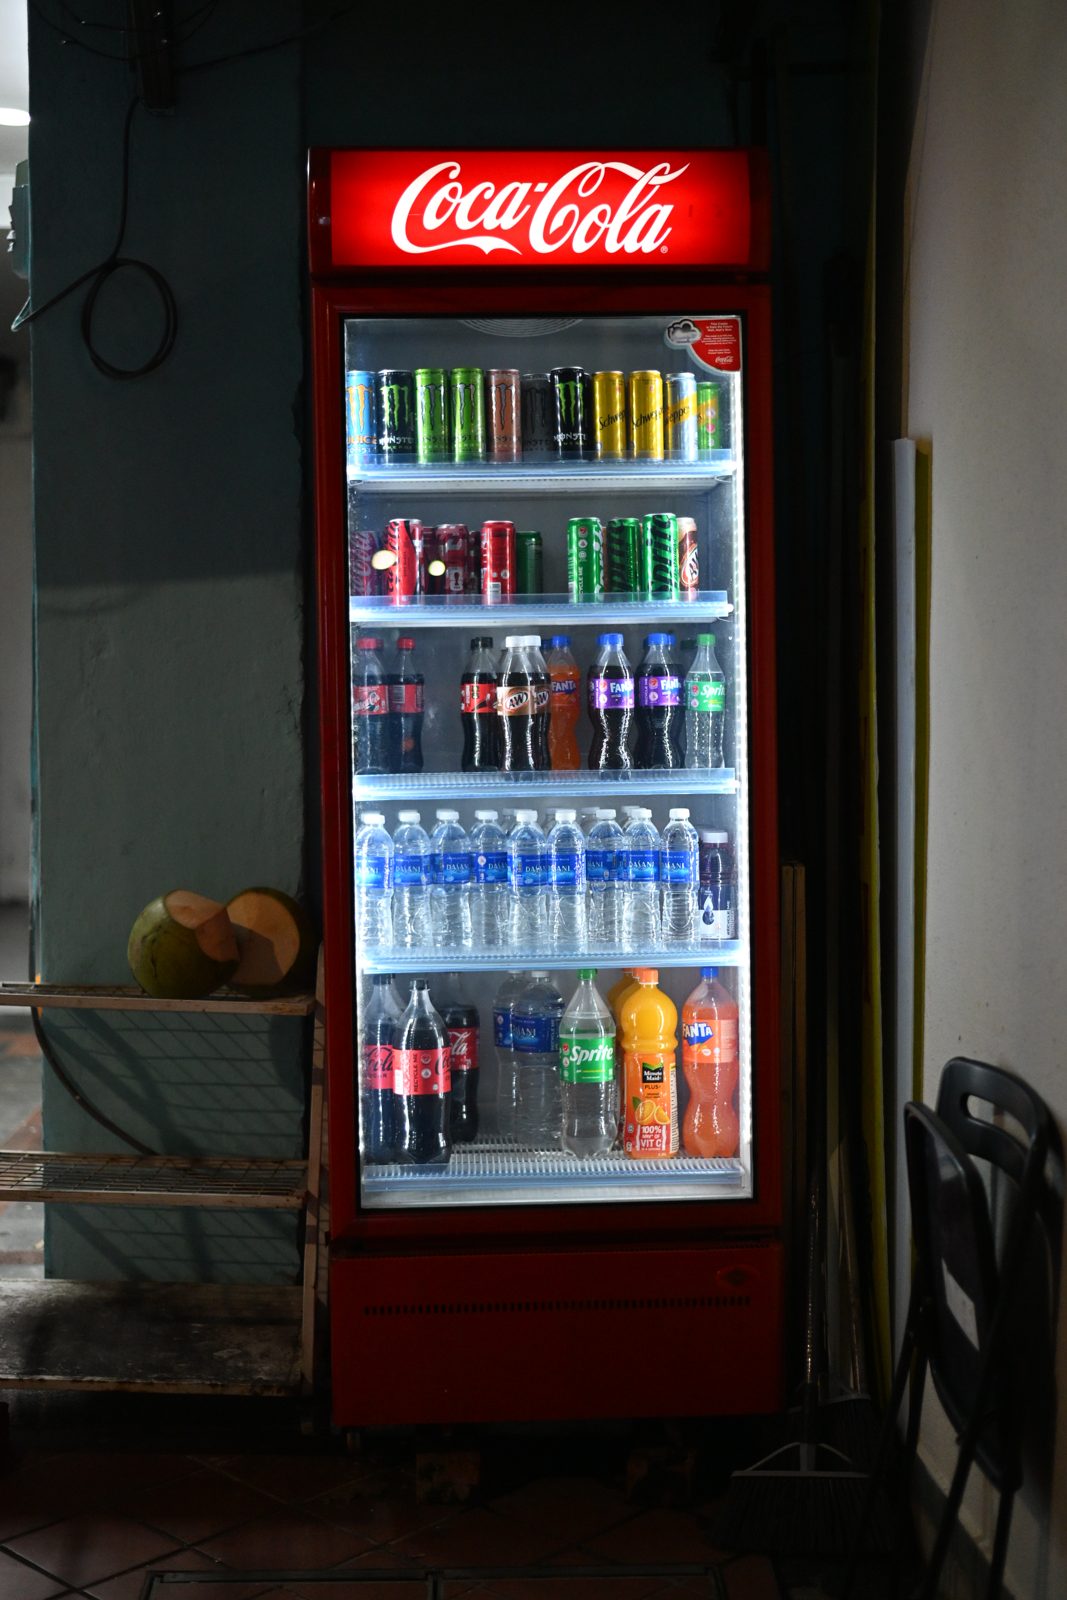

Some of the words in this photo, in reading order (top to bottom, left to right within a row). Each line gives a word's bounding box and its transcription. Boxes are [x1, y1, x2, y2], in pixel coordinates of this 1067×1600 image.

[391, 161, 691, 255] Coca-Cola
[682, 1022, 714, 1038] FANTA
[570, 1044, 614, 1066] Sprite
[641, 1125, 662, 1134] 100%
[641, 1139, 654, 1148] VIT
[656, 1139, 662, 1148] C
